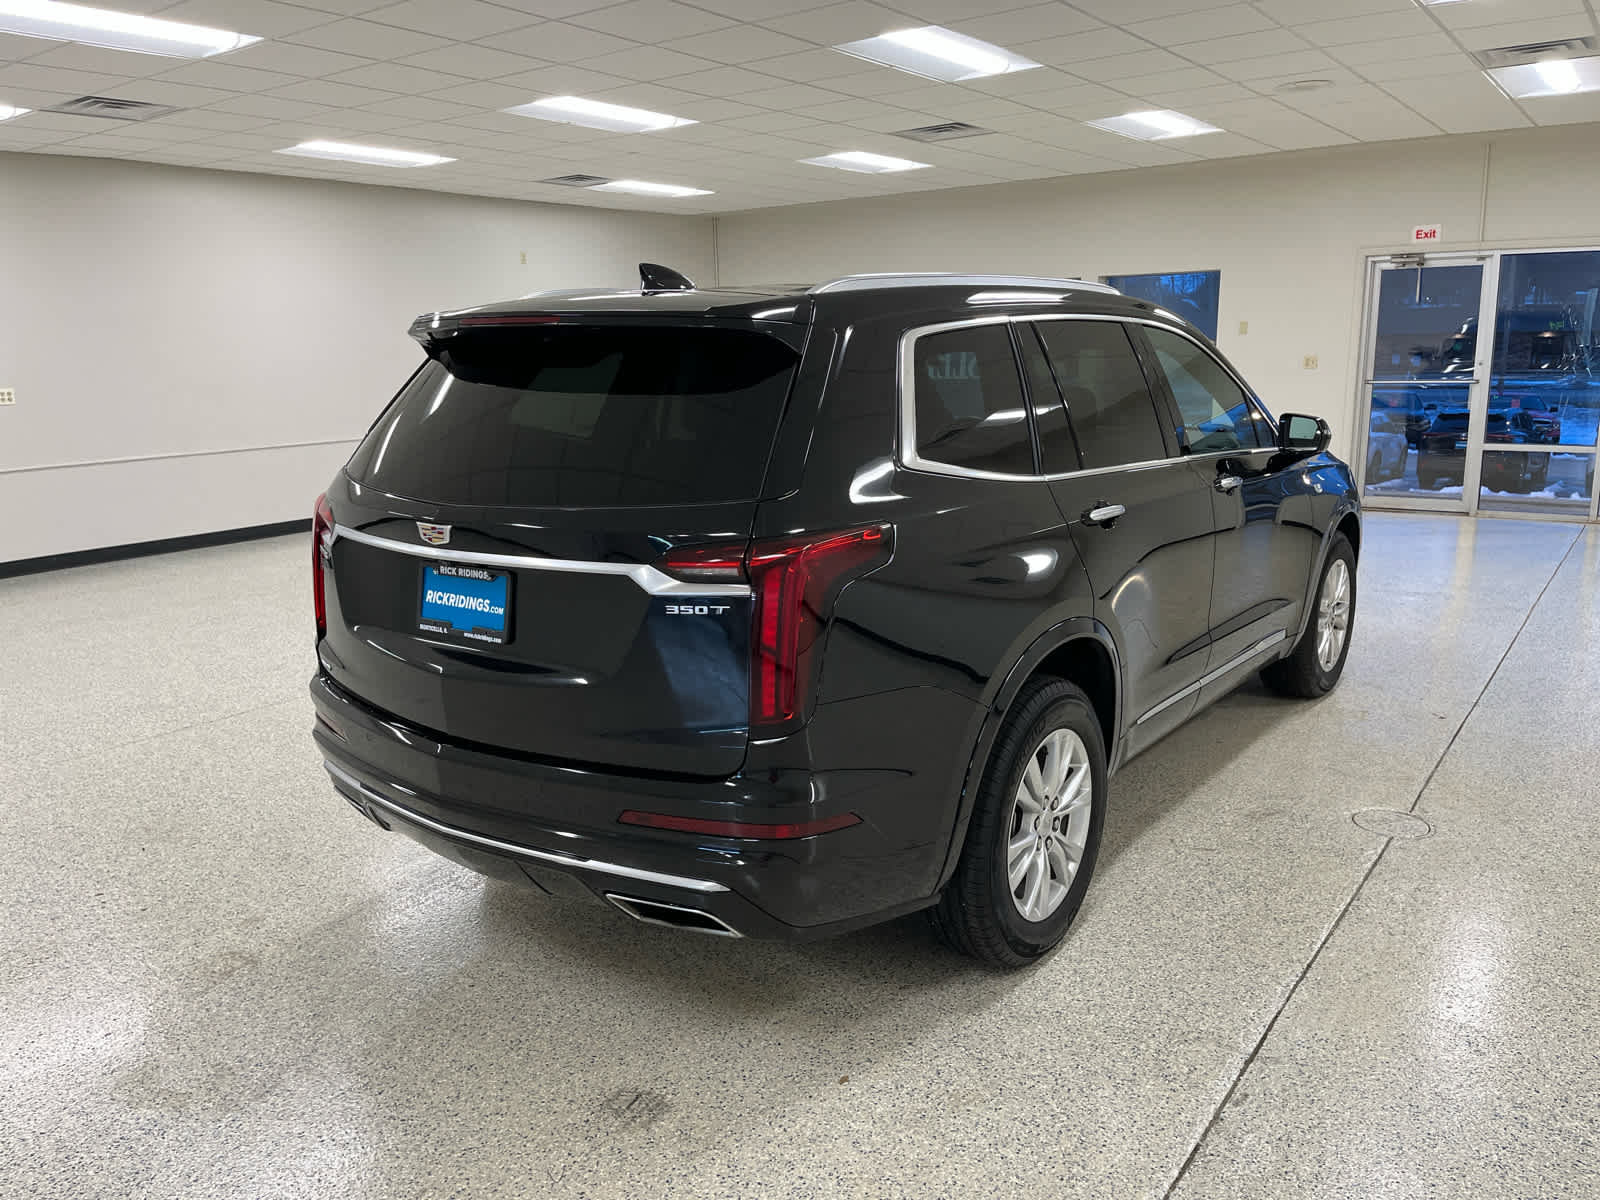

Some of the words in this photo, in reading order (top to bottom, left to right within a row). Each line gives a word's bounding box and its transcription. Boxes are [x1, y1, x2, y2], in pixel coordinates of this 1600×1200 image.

[1415, 229, 1437, 240] Exit
[440, 566, 457, 576] RICK
[458, 568, 489, 580] RIDINGS
[425, 589, 504, 615] RICKRIDINGS.COM
[664, 605, 731, 615] 350T
